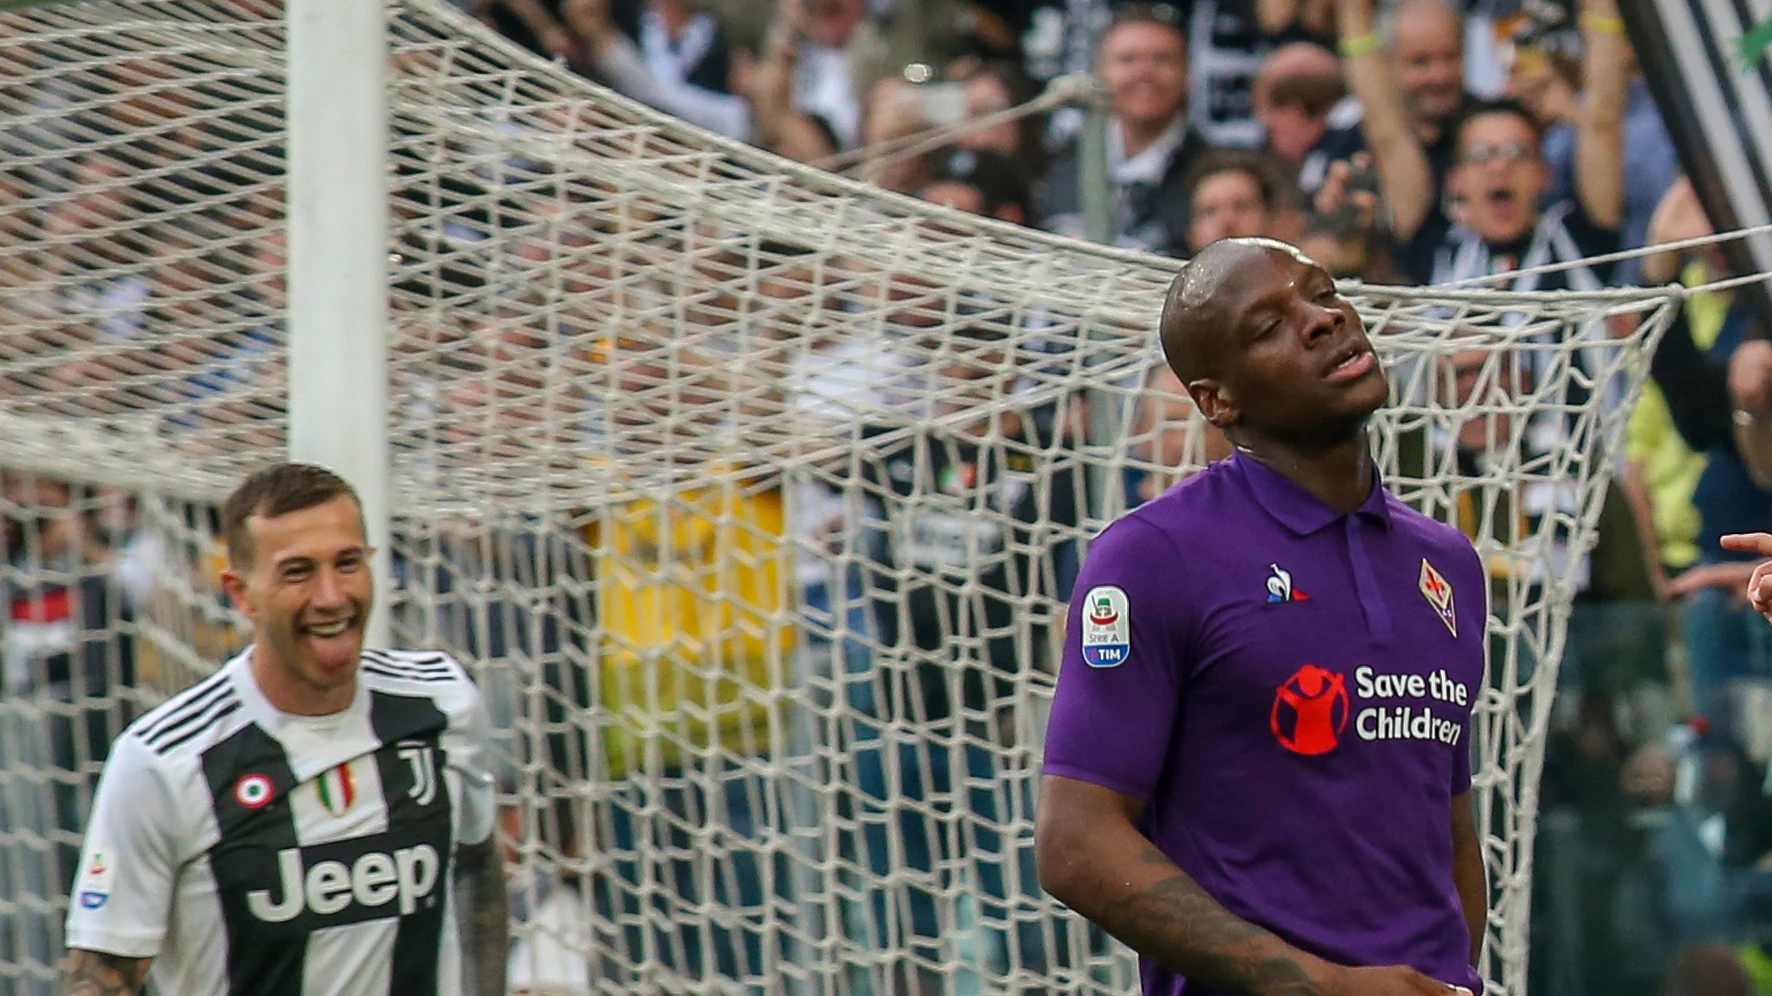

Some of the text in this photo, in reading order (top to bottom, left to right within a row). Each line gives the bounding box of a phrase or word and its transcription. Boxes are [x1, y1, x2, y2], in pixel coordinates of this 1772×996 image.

[1098, 648, 1121, 660] TIM
[1355, 665, 1468, 706] Save the
[1355, 706, 1462, 746] Children
[246, 843, 440, 923] Jeep
